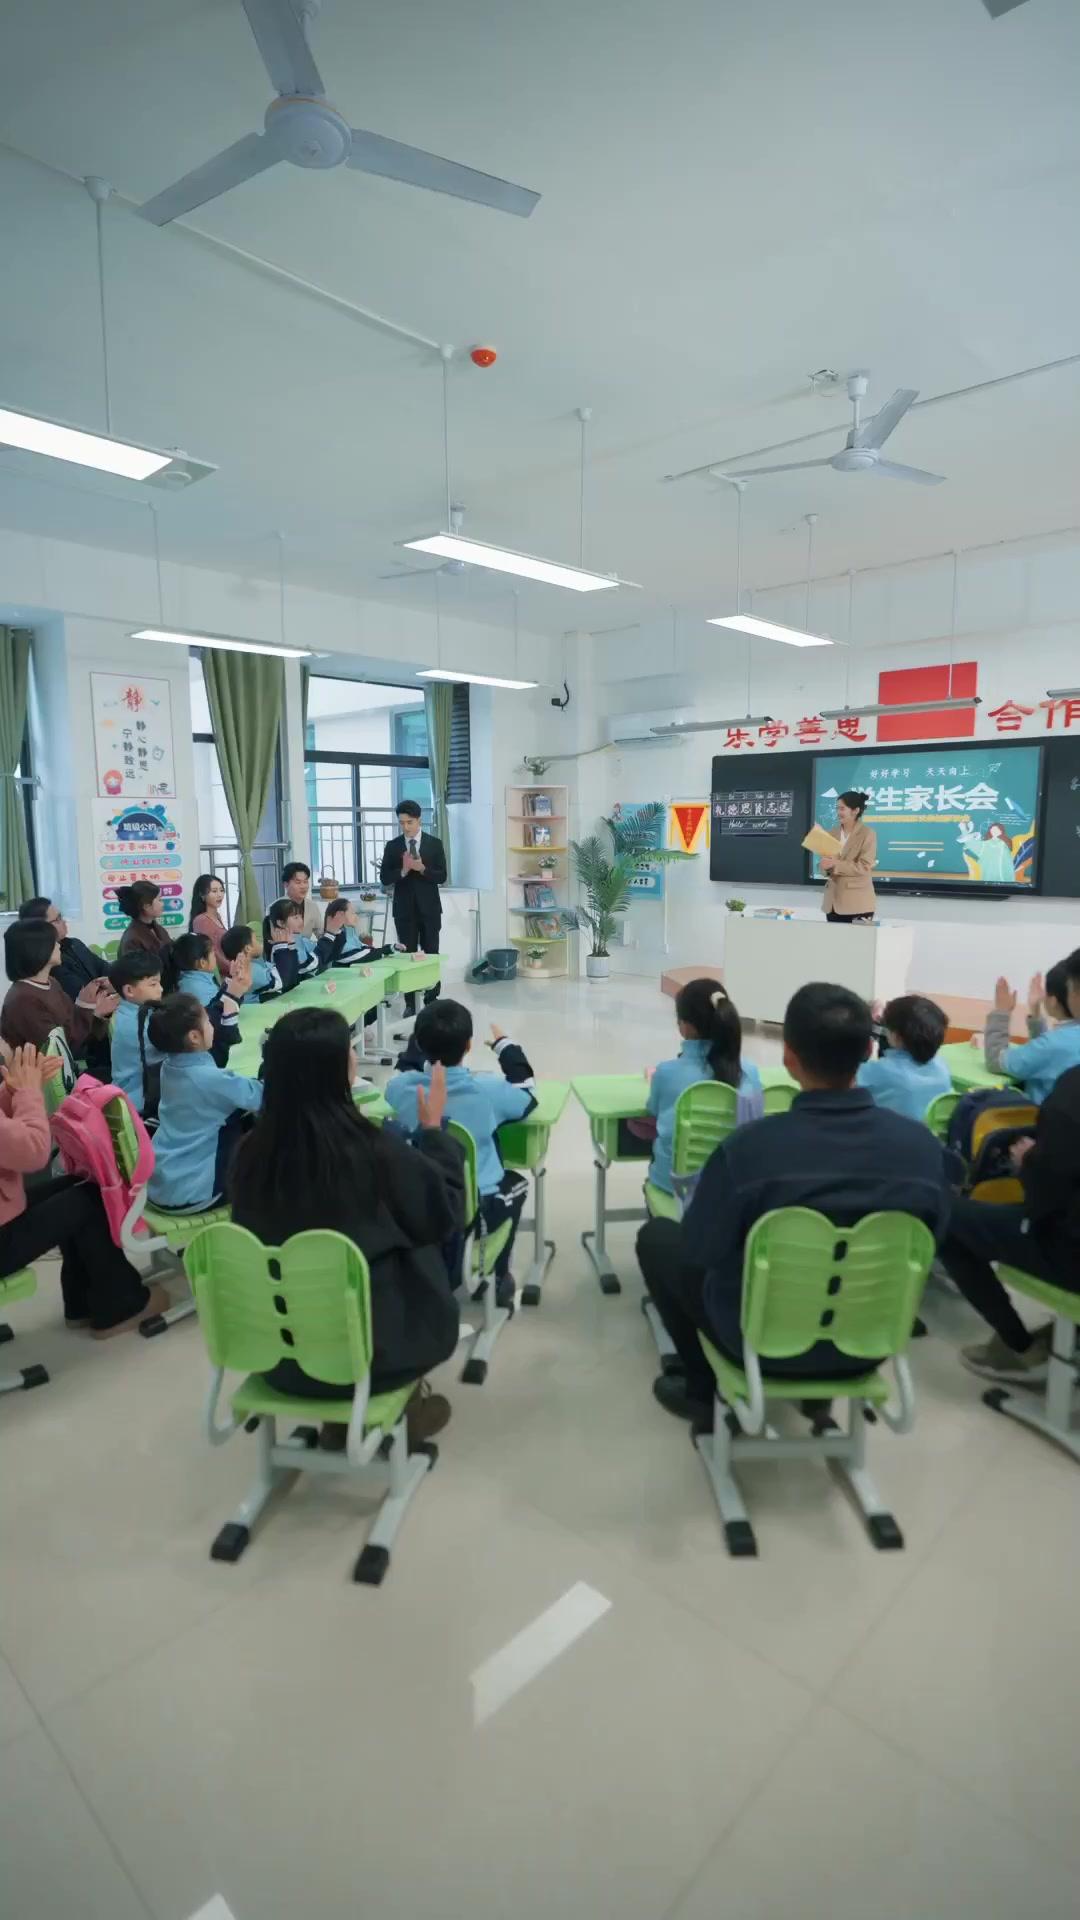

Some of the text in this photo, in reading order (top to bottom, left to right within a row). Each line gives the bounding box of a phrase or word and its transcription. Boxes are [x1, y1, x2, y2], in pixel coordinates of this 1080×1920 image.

[870, 765, 970, 779] 好好学习 天天向上
